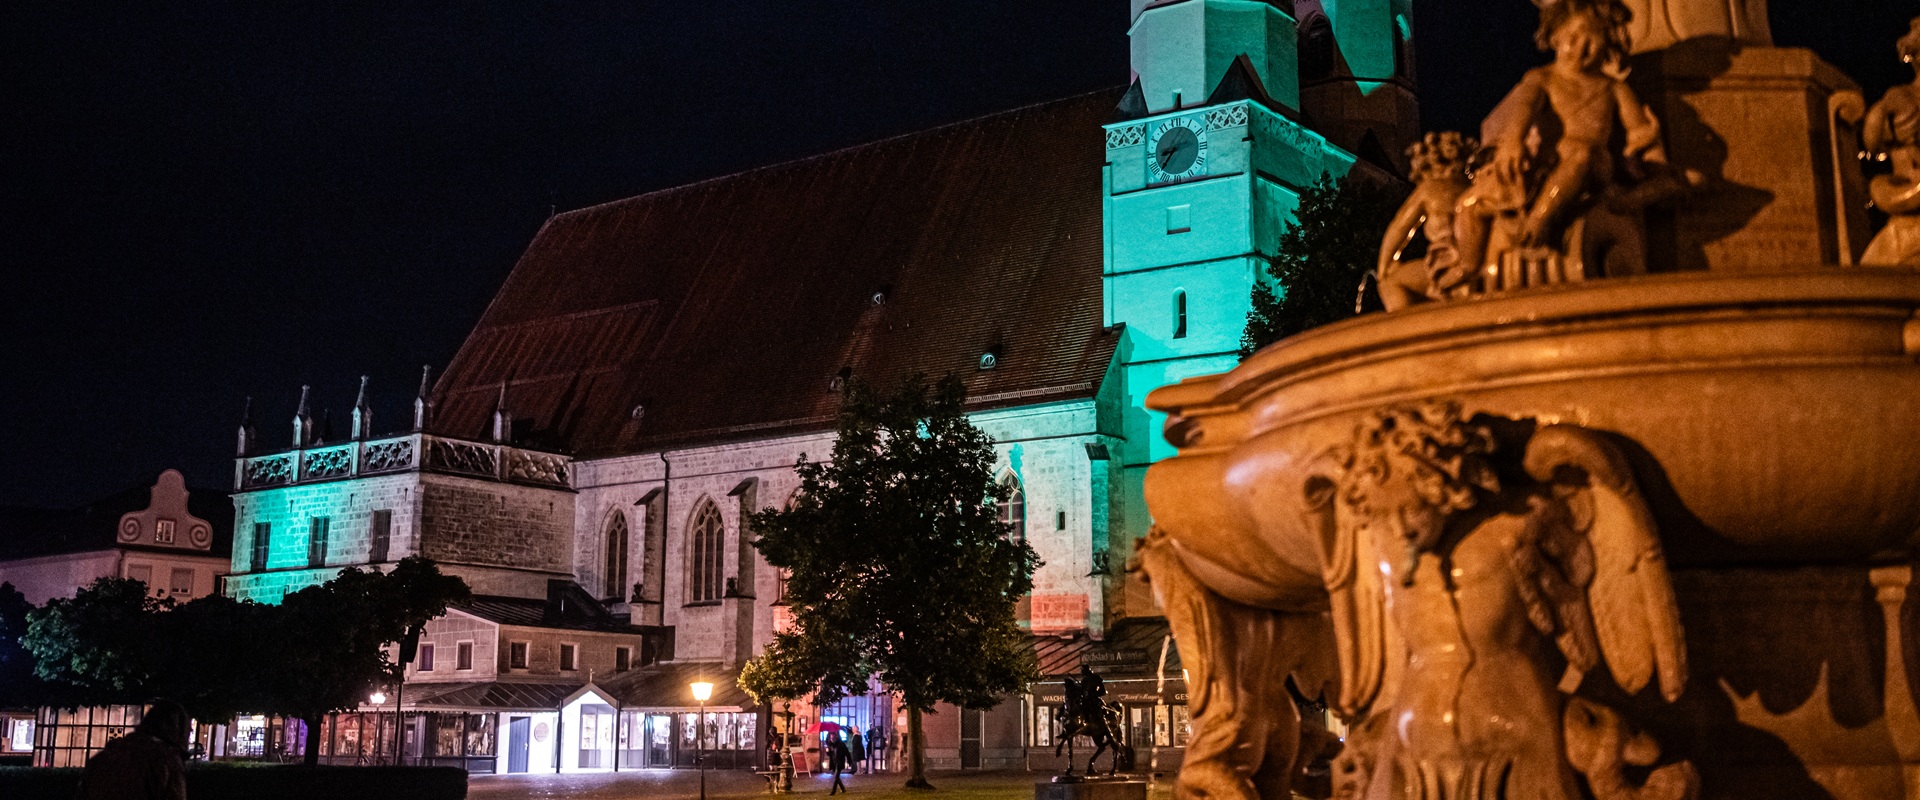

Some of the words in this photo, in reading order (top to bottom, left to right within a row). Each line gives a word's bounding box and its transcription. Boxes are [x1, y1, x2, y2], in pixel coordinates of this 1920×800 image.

[1170, 117, 1181, 127] XII
[1186, 119, 1192, 127] I
[1195, 128, 1204, 136] II
[1199, 141, 1208, 150] III
